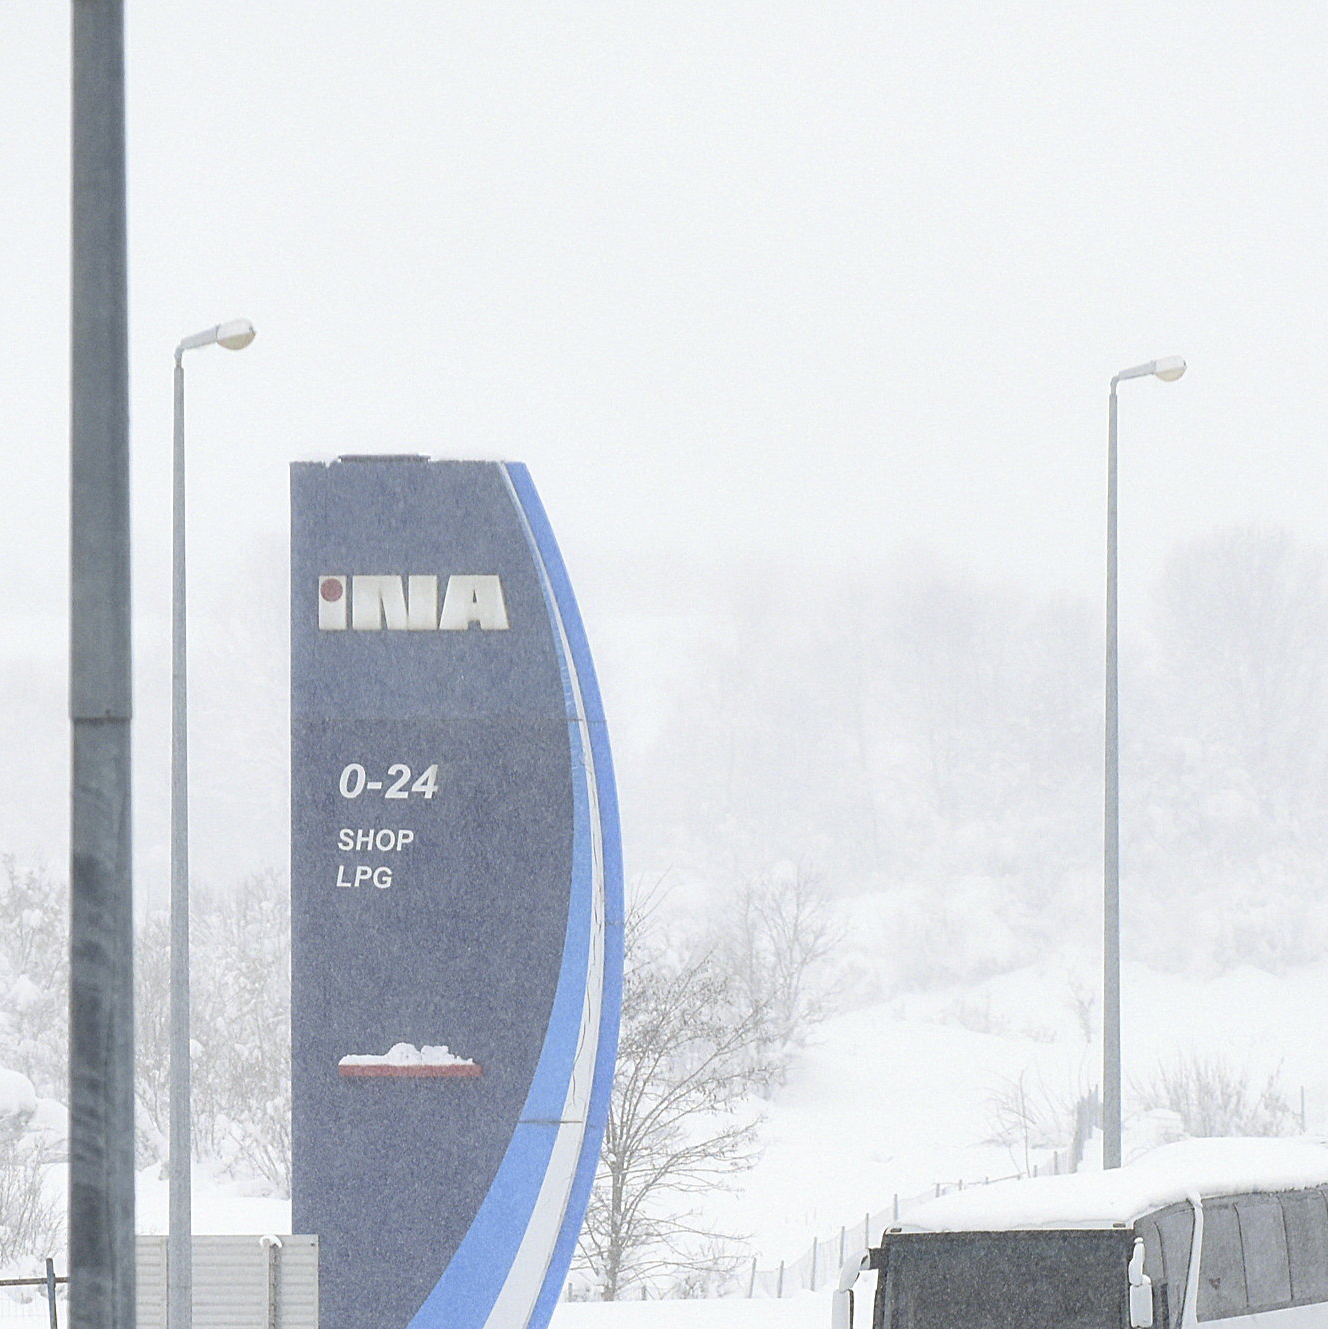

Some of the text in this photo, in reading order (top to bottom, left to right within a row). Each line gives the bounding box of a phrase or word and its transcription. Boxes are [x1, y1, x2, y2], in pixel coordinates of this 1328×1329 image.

[338, 763, 438, 799] 0-24
[337, 828, 414, 851] SHOP
[336, 865, 392, 889] LPG
